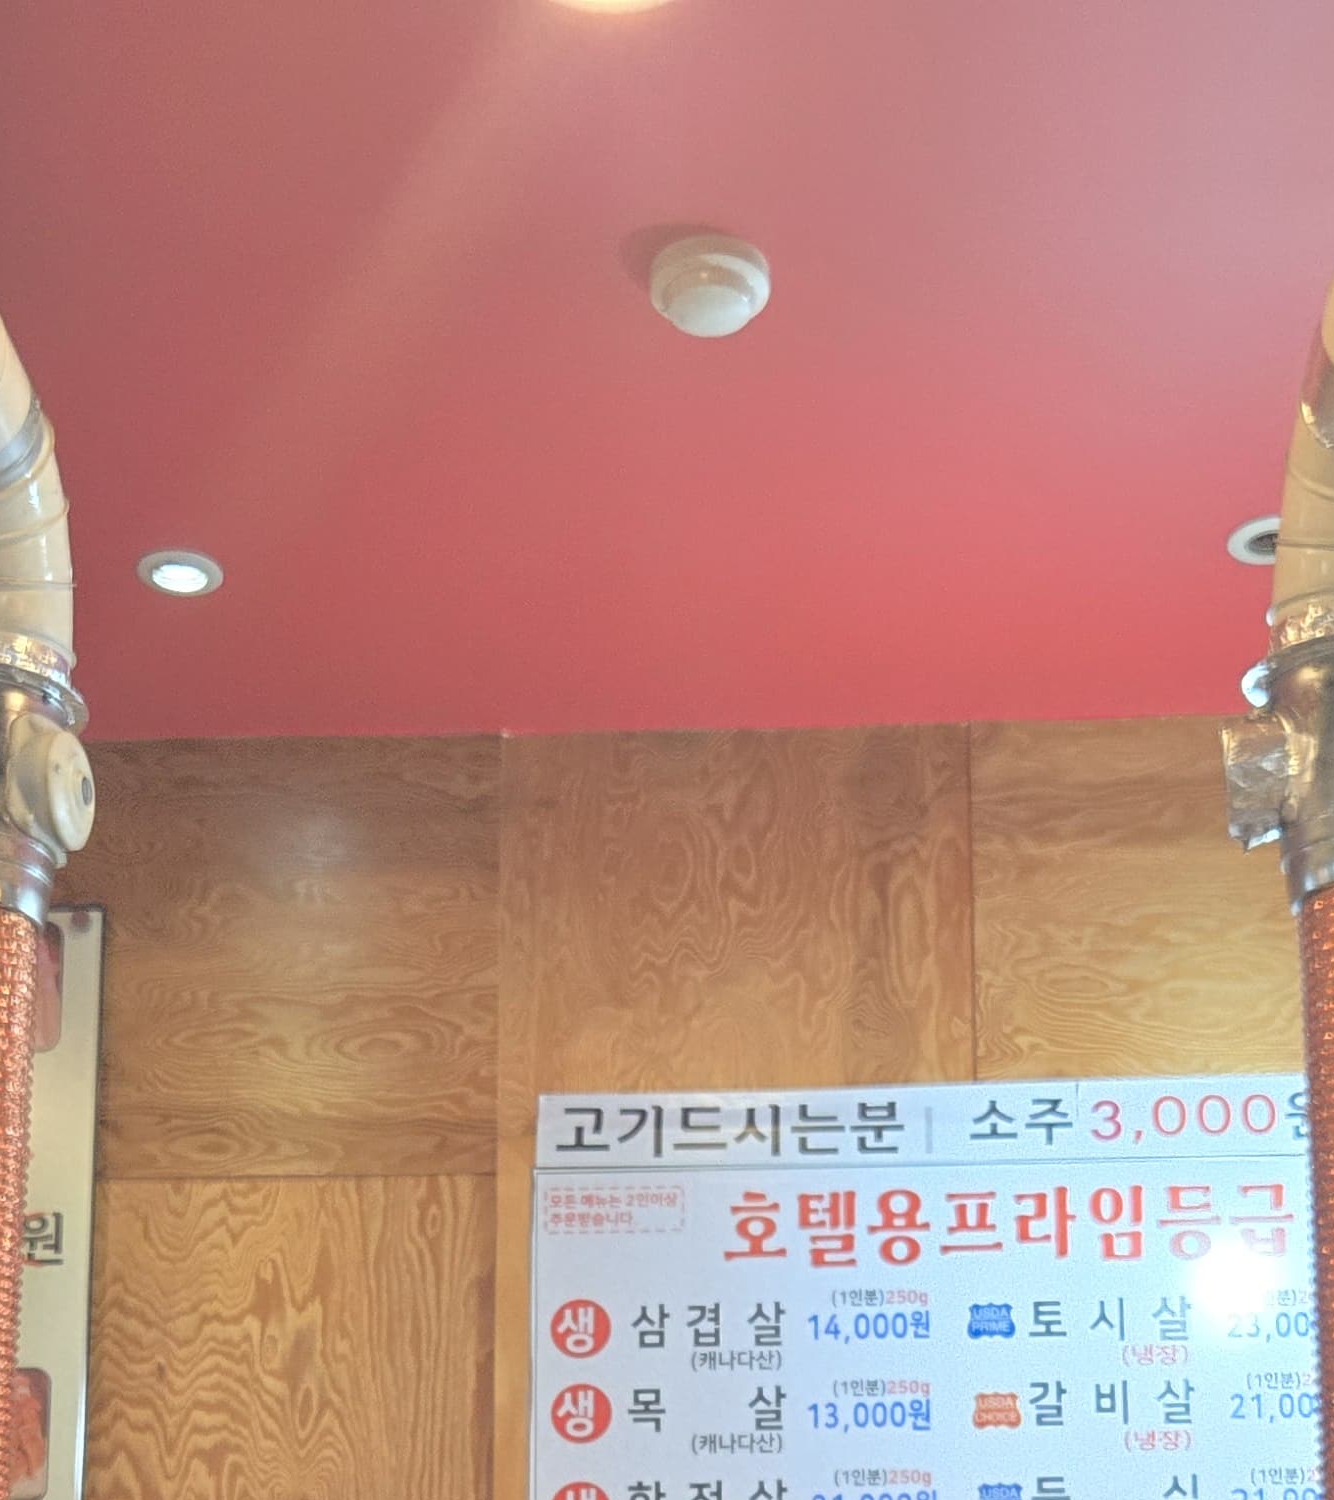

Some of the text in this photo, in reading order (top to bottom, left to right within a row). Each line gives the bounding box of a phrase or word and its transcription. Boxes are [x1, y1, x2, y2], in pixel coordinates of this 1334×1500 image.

[555, 1101, 905, 1158] 고기드시는분
[969, 1097, 1073, 1146] 소주
[723, 1182, 1295, 1269] 호텔용프라임등급
[631, 1301, 787, 1349] 삼겹살
[807, 1310, 933, 1344] 14,000원
[808, 1399, 932, 1434] 13,000원
[1028, 1379, 1319, 1427] 갈비살 21,00
